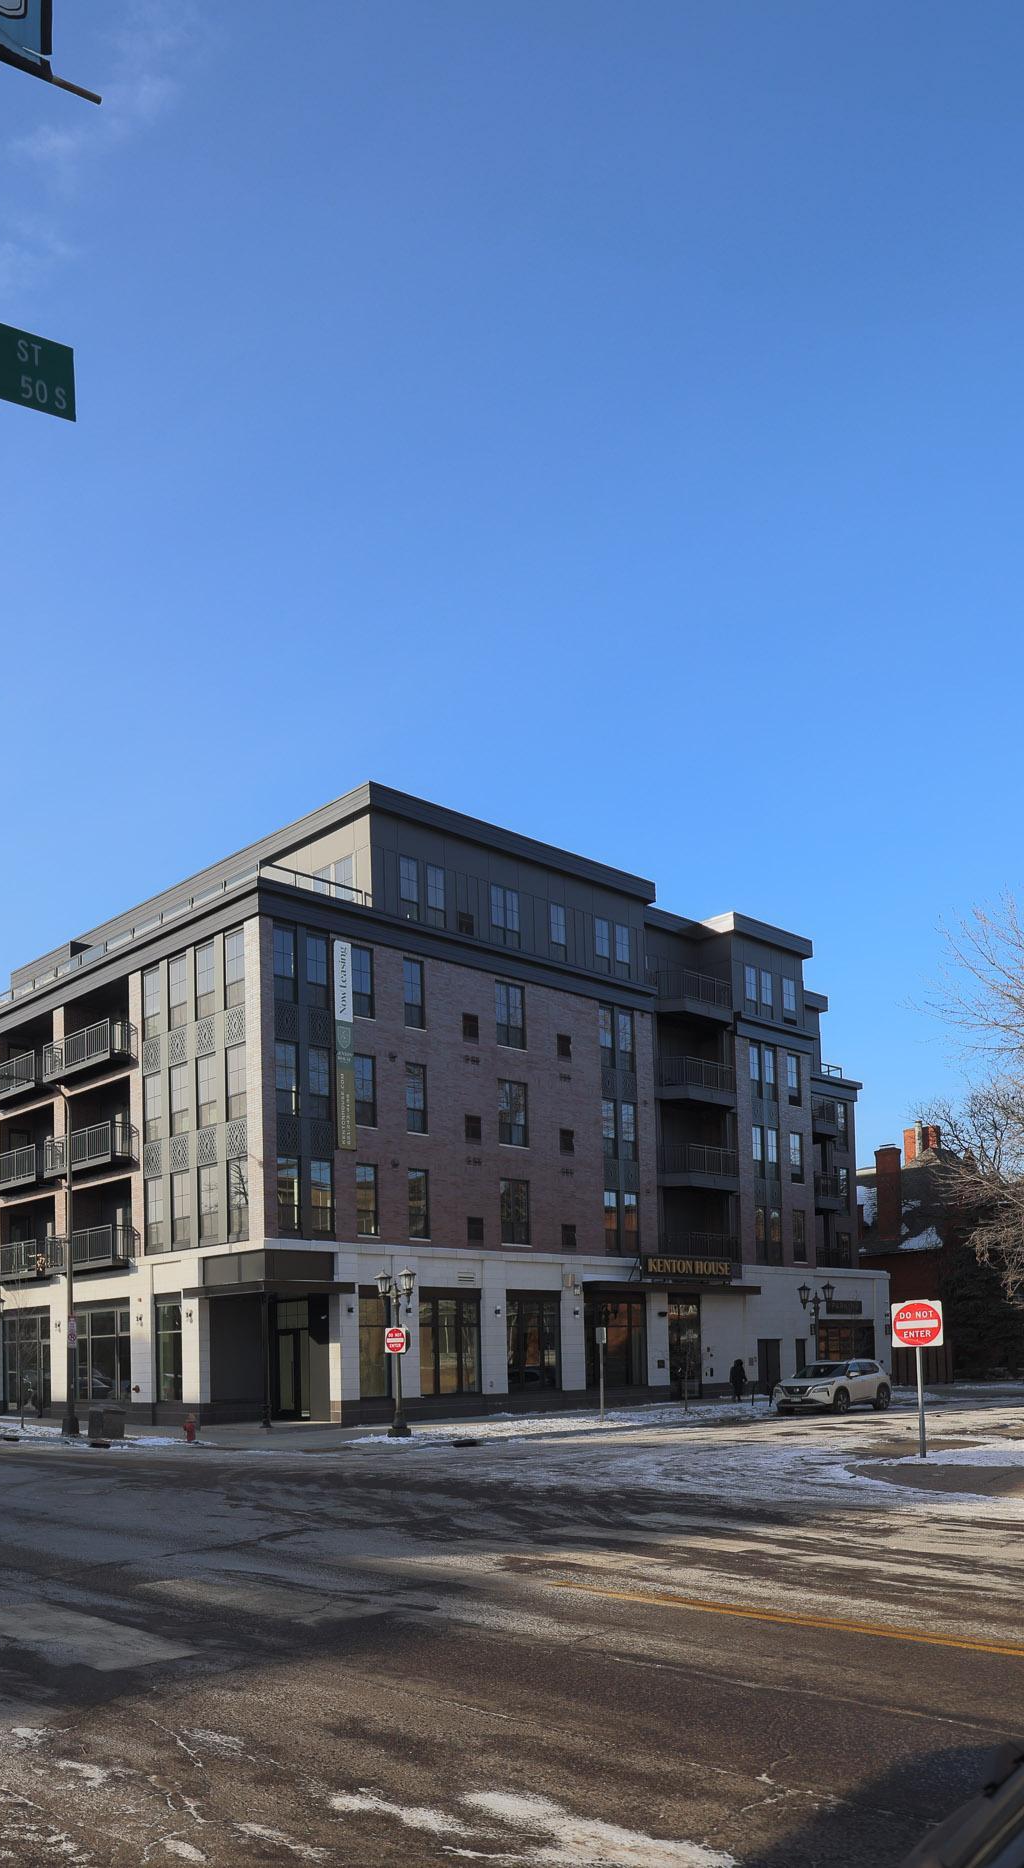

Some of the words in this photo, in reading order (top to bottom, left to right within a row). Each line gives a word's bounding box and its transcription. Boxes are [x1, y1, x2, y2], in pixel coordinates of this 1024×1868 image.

[17, 339, 42, 367] ST
[20, 376, 48, 404] 50
[54, 387, 67, 410] S
[339, 946, 348, 989] Leasing
[339, 992, 347, 1014] Now
[647, 1258, 693, 1274] KENTON
[696, 1260, 731, 1276] HOUSE
[899, 1311, 912, 1320] DO
[915, 1310, 934, 1319] NOT
[903, 1329, 932, 1339] ENTER
